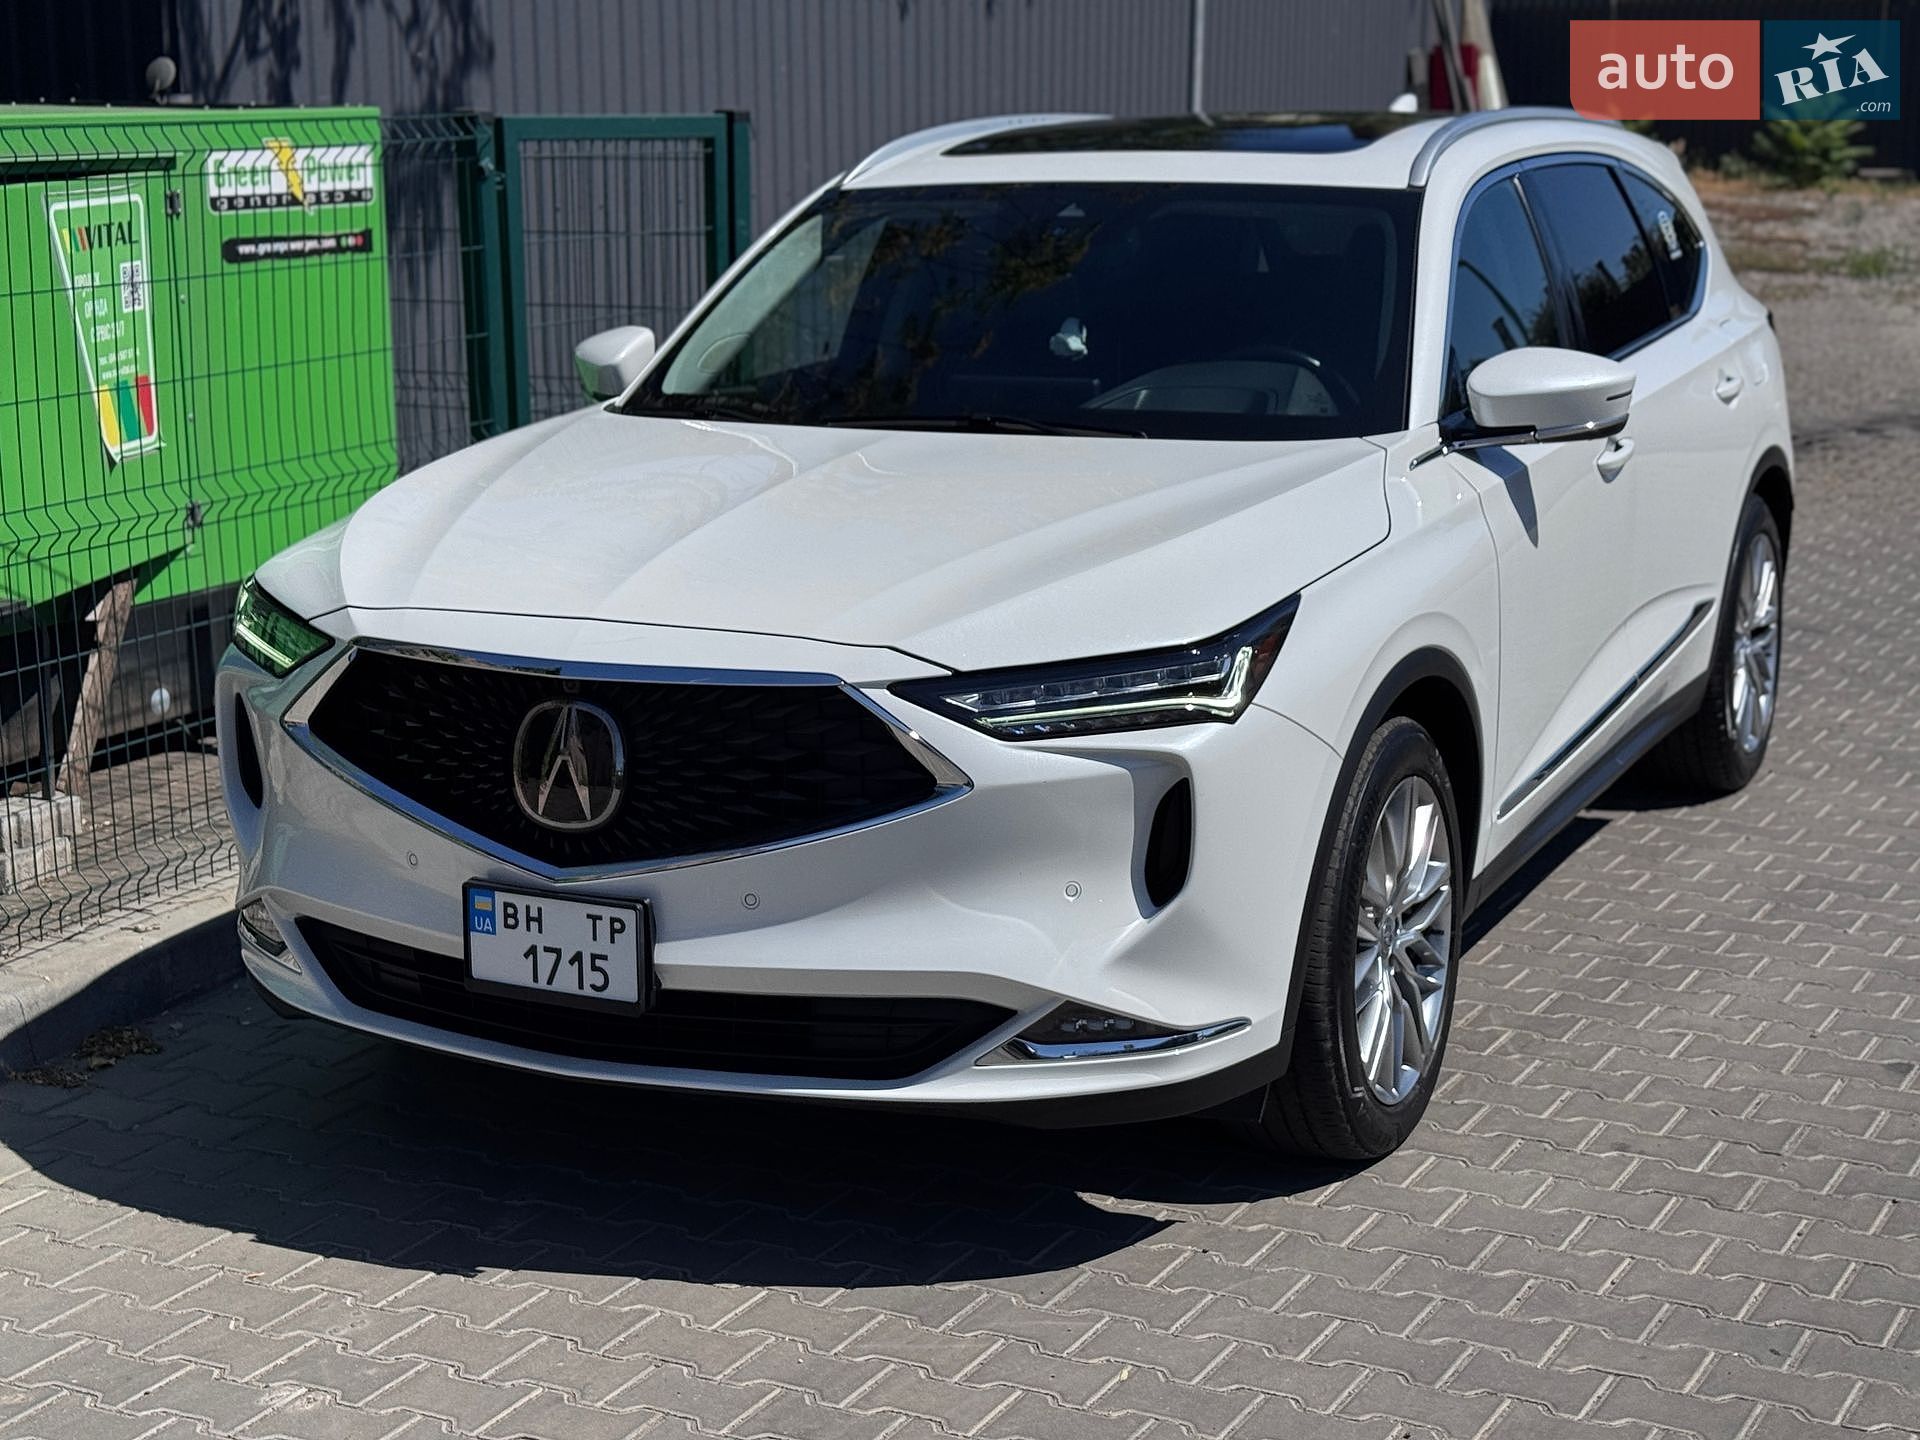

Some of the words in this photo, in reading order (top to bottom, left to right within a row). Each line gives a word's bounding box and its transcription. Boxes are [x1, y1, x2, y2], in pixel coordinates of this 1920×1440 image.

[213, 158, 271, 188] Green
[304, 156, 365, 184] Power
[84, 221, 139, 250] VITAL
[474, 916, 493, 932] UA
[503, 901, 543, 934] BH
[586, 913, 626, 944] TP
[523, 944, 610, 992] 1715
